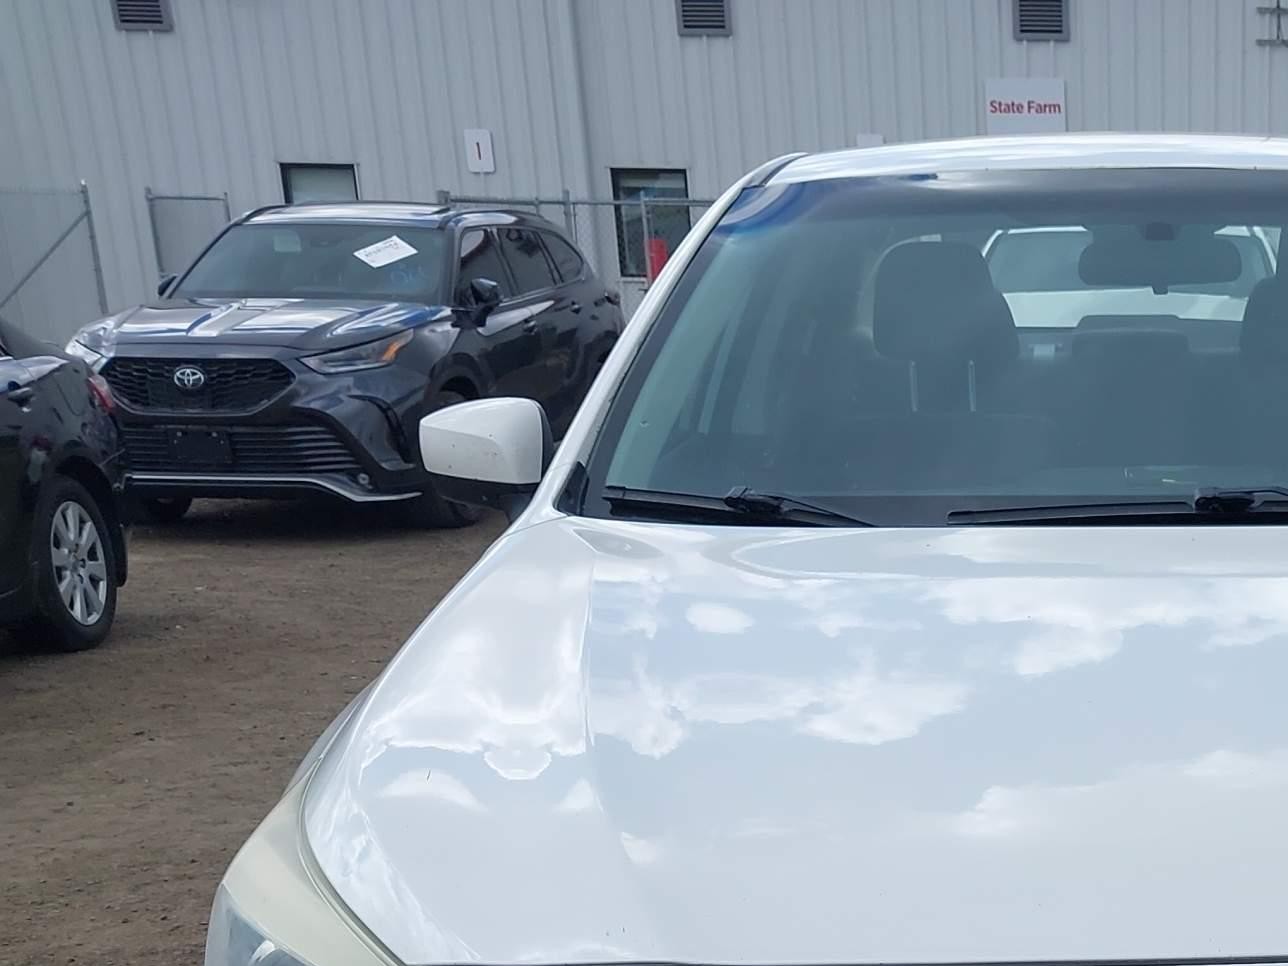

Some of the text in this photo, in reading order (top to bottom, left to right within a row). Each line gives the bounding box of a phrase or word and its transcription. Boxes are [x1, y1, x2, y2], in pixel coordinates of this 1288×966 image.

[989, 99, 1062, 114] State Farm
[475, 141, 482, 161] 1
